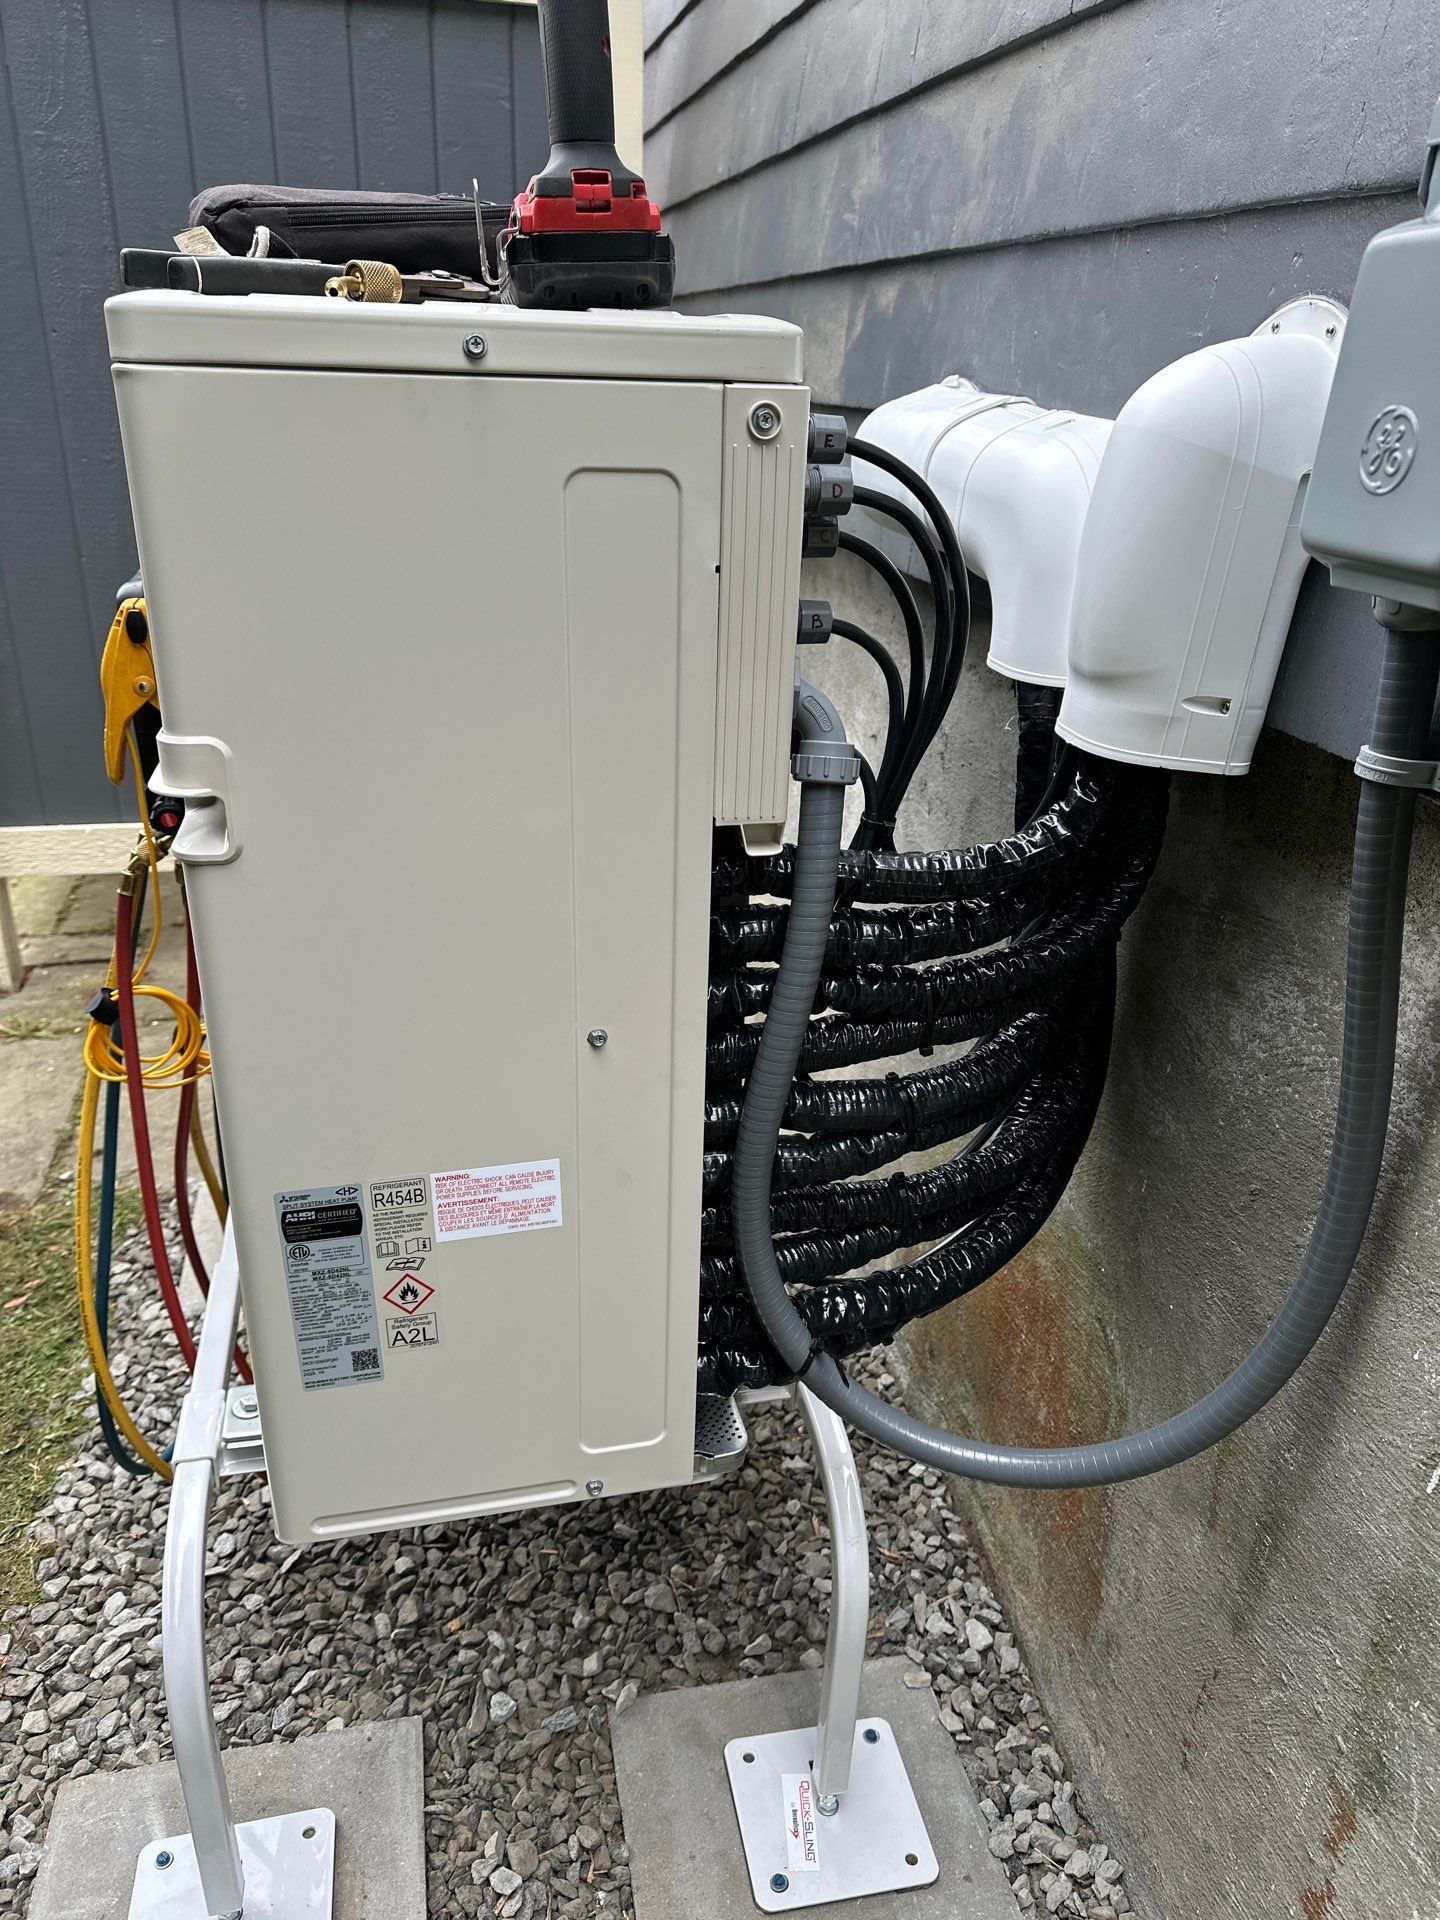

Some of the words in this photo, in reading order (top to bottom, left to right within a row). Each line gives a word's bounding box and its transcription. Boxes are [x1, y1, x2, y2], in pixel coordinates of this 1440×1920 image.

[824, 433, 834, 450] E
[832, 483, 843, 498] D
[811, 614, 823, 629] B
[435, 1174, 471, 1182] WARNING:
[458, 1178, 483, 1186] ELECTRIC
[517, 1171, 534, 1179] CAUSE
[464, 1182, 497, 1191] DISCONNECT
[509, 1178, 530, 1186] REMOTE
[531, 1175, 556, 1183] ELECTRIC
[373, 1180, 422, 1191] REFRIGERANT
[374, 1188, 424, 1208] R454B
[457, 1190, 481, 1198] SUPPLIES
[483, 1187, 503, 1195] BEFORE
[283, 1199, 324, 1210] SPLIT-SYSTEM
[438, 1208, 457, 1216] RISQUE
[536, 1195, 556, 1203] CAUSER
[393, 1217, 424, 1225] INSTALLATION
[450, 1211, 479, 1220] BLESSURES
[476, 1214, 502, 1222] SOURCES
[392, 1227, 422, 1235] INSTALLATION
[445, 1224, 470, 1232] DISTANCE
[394, 1315, 428, 1324] Refrigerant
[392, 1327, 435, 1346] A2L
